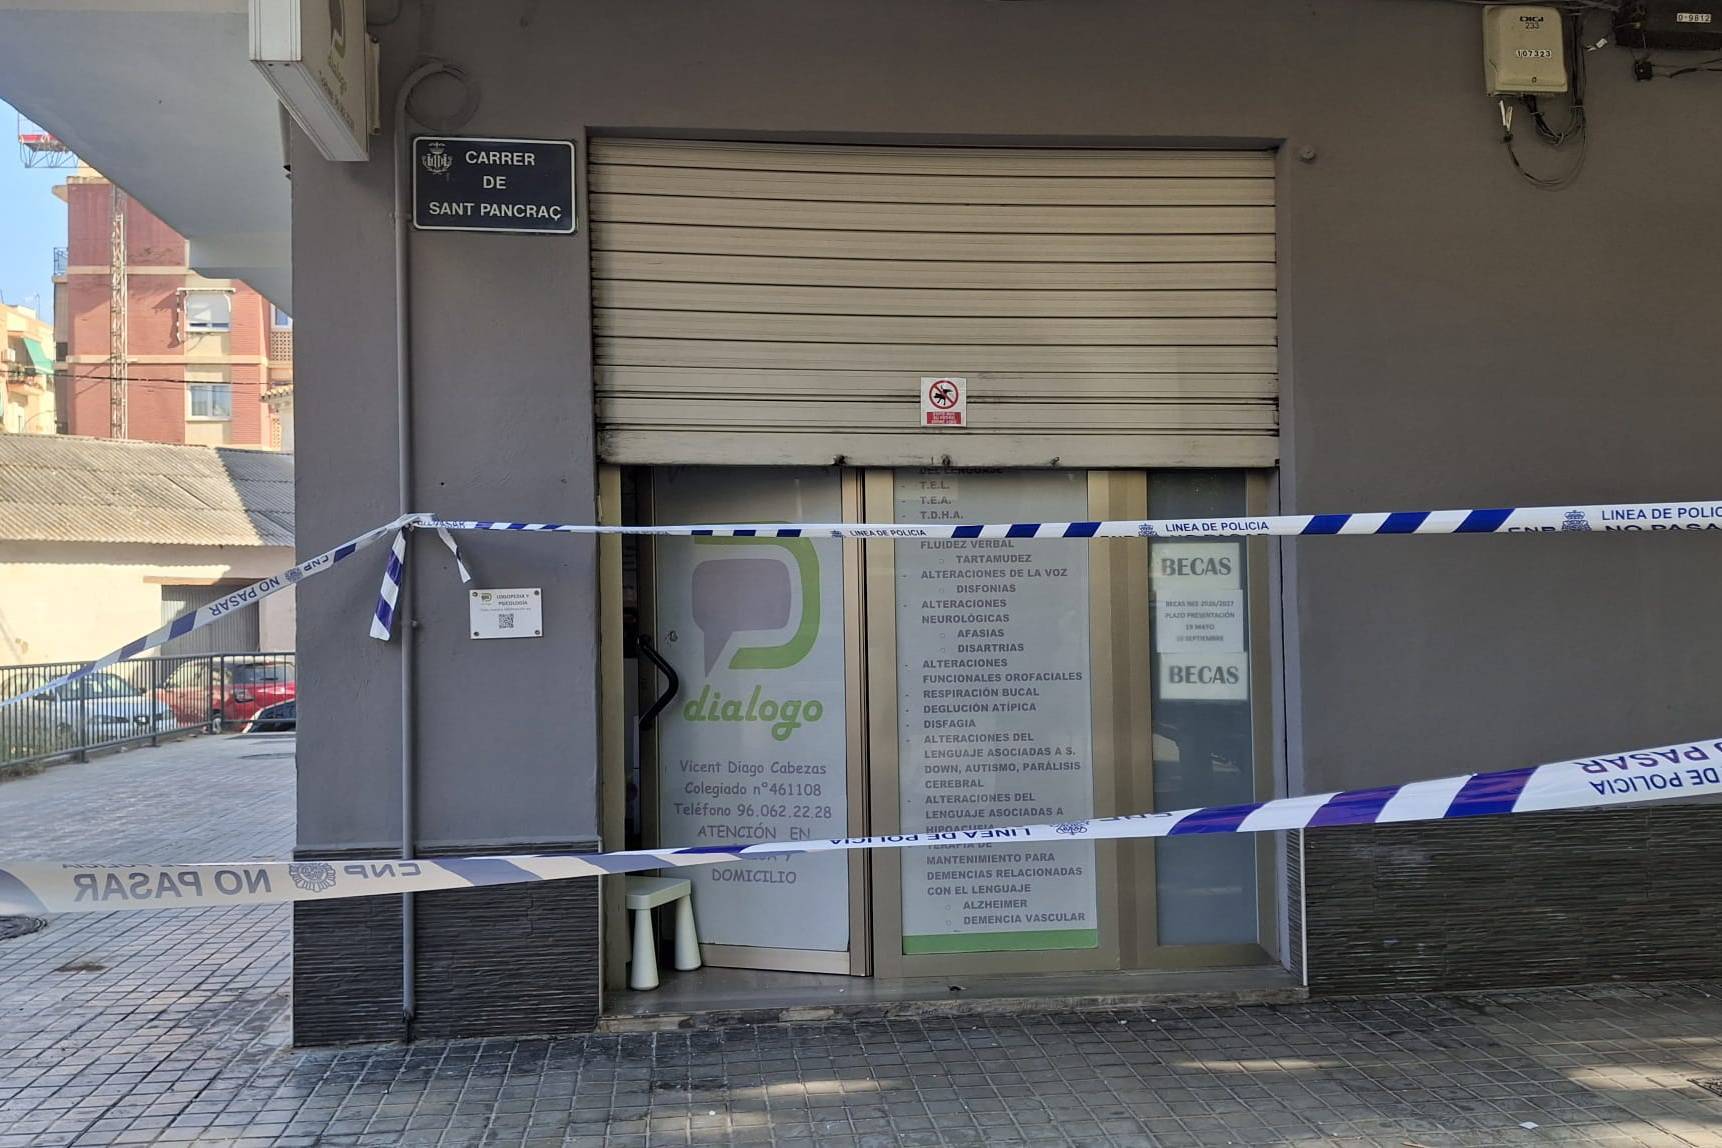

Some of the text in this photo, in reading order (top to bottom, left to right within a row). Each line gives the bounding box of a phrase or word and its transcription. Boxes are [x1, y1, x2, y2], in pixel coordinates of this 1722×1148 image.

[465, 151, 535, 166] CARRER
[483, 175, 507, 189] DE
[429, 202, 562, 222] SANT PANCRAÇ
[920, 480, 950, 490] T.E.L.
[920, 496, 952, 505] T.E.A.
[921, 511, 964, 520] T.D.H.A.
[1602, 508, 1647, 521] LINEA
[1651, 507, 1673, 520] DE
[876, 529, 888, 537] DE
[890, 529, 927, 537] POLICIA
[1165, 521, 1270, 533] LINEA DE POLICIA
[921, 539, 1015, 550] FLUIDEZ VERBAL
[956, 554, 1032, 564] TARTAMUDEZ
[1161, 557, 1231, 576] BECAS
[921, 568, 1068, 579] ALTERACIONES DE LA VOZ
[259, 576, 280, 592] NO
[208, 587, 258, 617] PASAR
[922, 599, 1007, 609] ALTERACIONES
[957, 629, 1005, 638] AFASIAS
[957, 643, 1025, 653] DISARTRIAS
[923, 658, 1008, 669] ALTERACIONES
[923, 672, 1083, 684] FUNCIONALES OROFACIALES
[1168, 665, 1239, 685] BECAS
[923, 688, 1040, 699] RESPIRACIÓN BUCAL
[683, 684, 824, 742] dialogo
[923, 701, 1037, 714] DEGLUCIÓN ATÍPICA
[924, 719, 976, 729] DISFAGIA
[924, 733, 1034, 744] ALTERACIONES DEL
[924, 747, 1076, 759] LENGUAJE ASOCIADAS A S.
[1573, 746, 1710, 774] PASAR
[680, 760, 827, 776] Vicent Diago Cabezas
[925, 760, 1081, 775] DOWN, AUTISMO, PARÁLISIS
[925, 780, 984, 789] CEREBRAL
[1589, 767, 1721, 795] DE POLICIA
[684, 781, 747, 798] Colegiado
[925, 793, 1036, 804] ALTERACIONES DEL
[673, 802, 832, 819] Teléfono 96.062.22.28
[925, 807, 1064, 819] LENGUAJE ASOCIADAS A
[698, 822, 810, 840] ATENCIÓN EN
[831, 828, 1031, 845] LINEA DE POLICIA
[927, 853, 1056, 865] MANTENIMIENTO PARA
[712, 868, 797, 884] DOMICILIO
[927, 867, 1083, 881] DEMENCIAS RELACIONADAS
[927, 884, 1032, 896] CON EL LENGUAJE
[963, 899, 1028, 910] ALZHEIMER
[963, 912, 1086, 925] DEMENCIA VASCULAR
